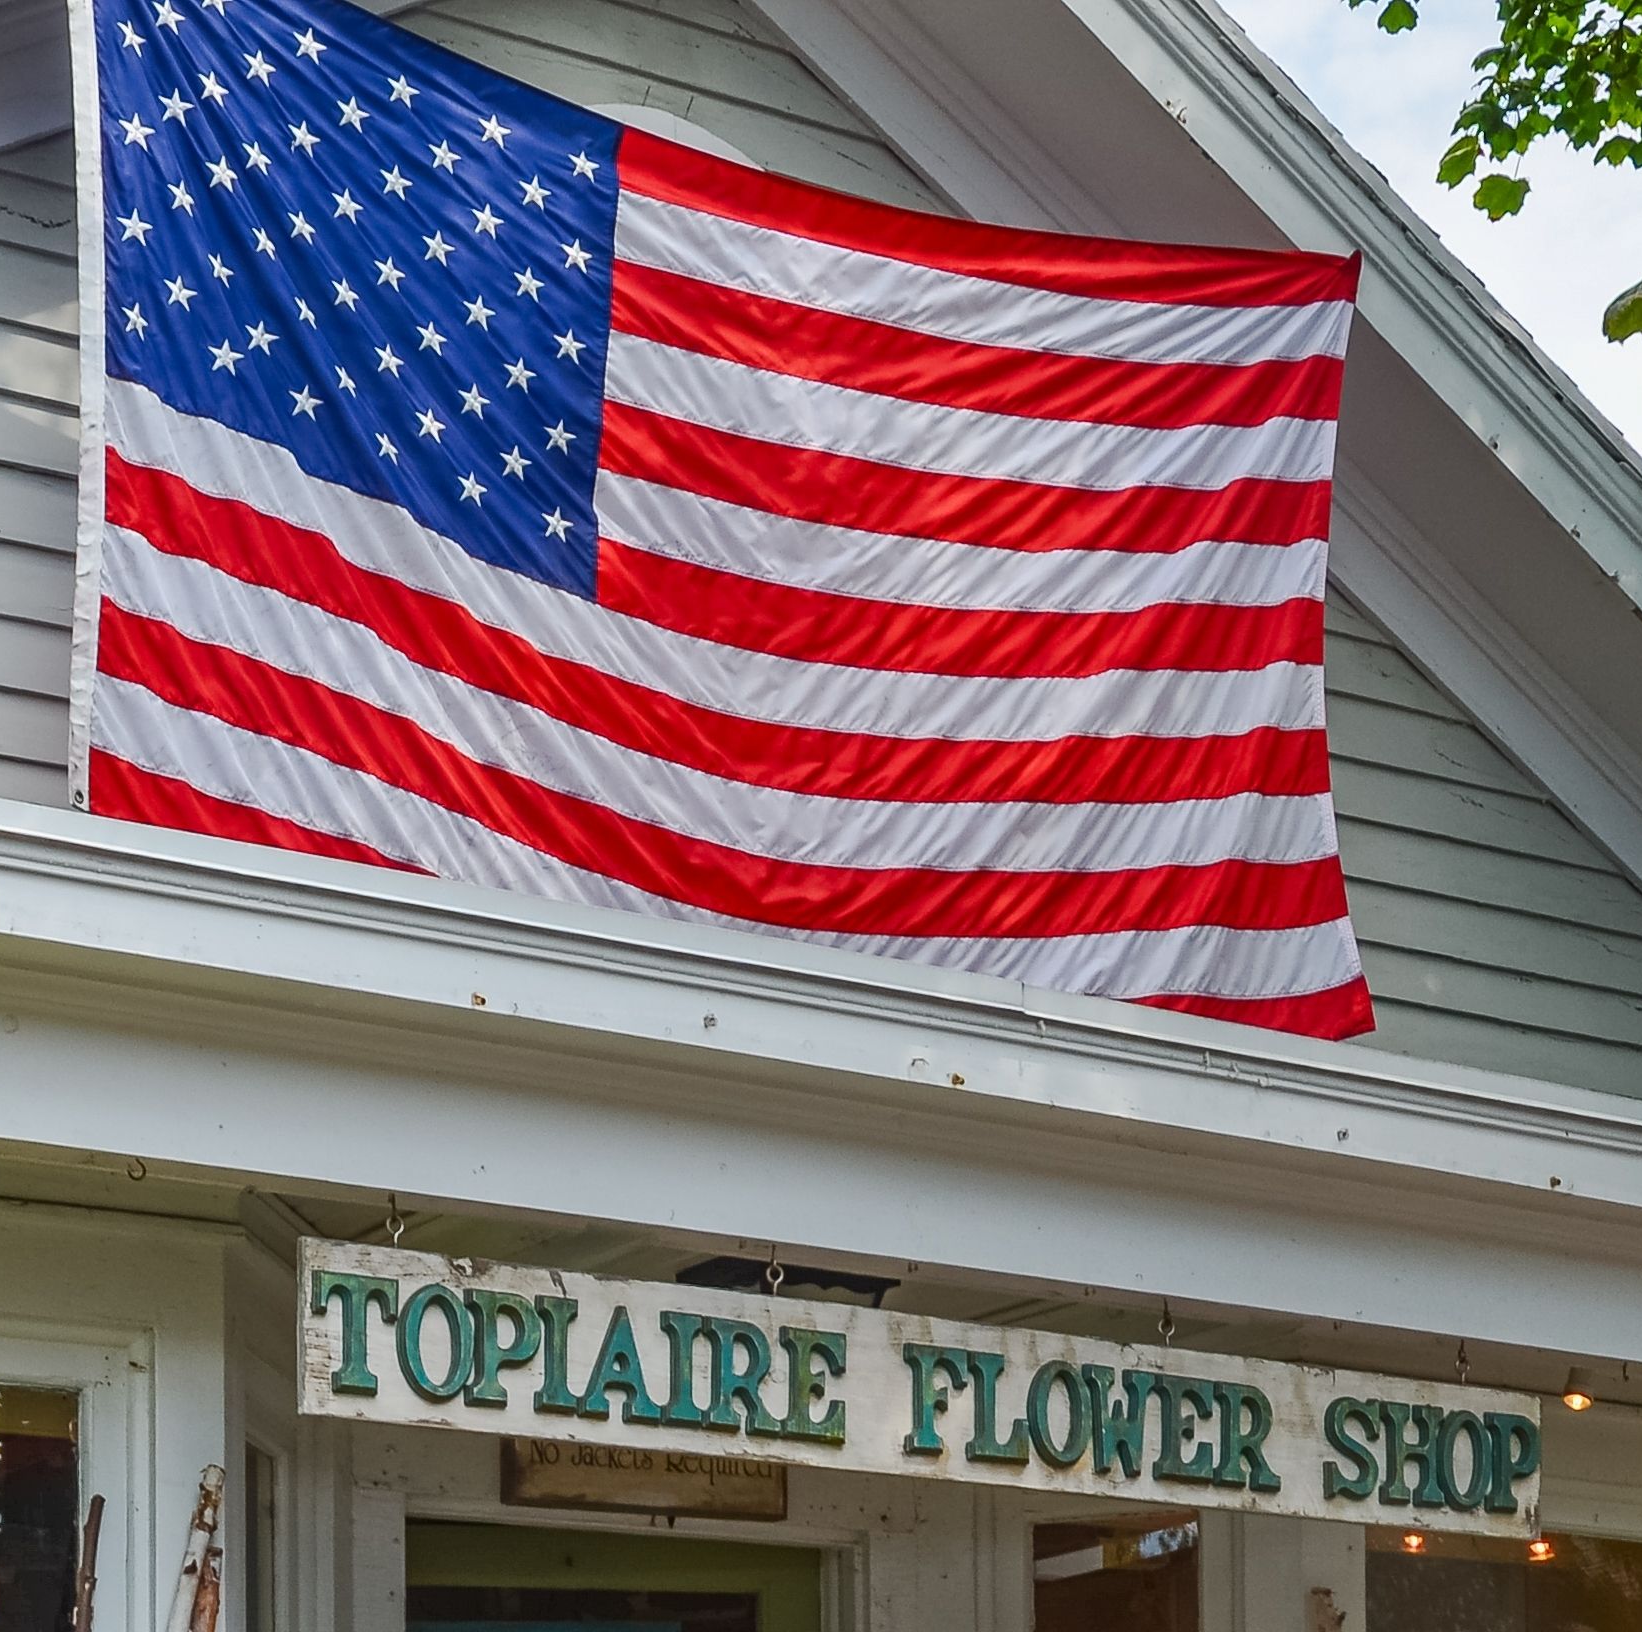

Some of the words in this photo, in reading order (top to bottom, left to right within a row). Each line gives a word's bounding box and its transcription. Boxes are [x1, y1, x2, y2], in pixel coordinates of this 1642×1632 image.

[311, 1270, 847, 1446] TOPIAIRE
[903, 1343, 1282, 1492] FLOWER
[1323, 1395, 1540, 1512] SHOP
